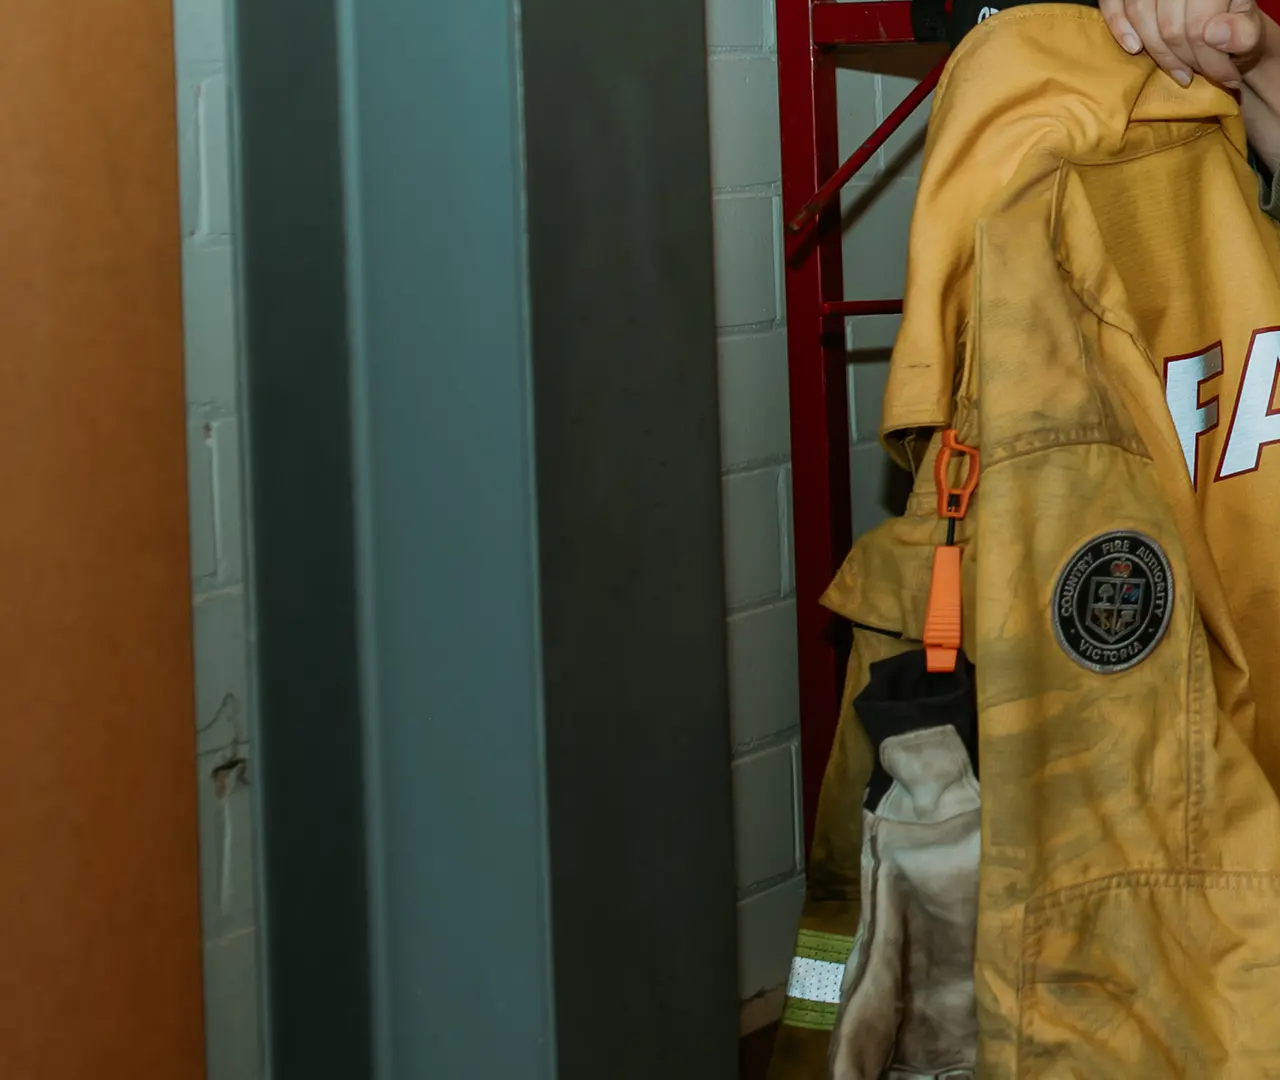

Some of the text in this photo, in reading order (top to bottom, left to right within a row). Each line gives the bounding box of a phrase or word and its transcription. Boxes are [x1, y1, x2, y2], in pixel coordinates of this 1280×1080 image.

[1061, 540, 1165, 618] COUNTRY FIRE AUTHORITY
[1079, 639, 1143, 662] VICTORIA
